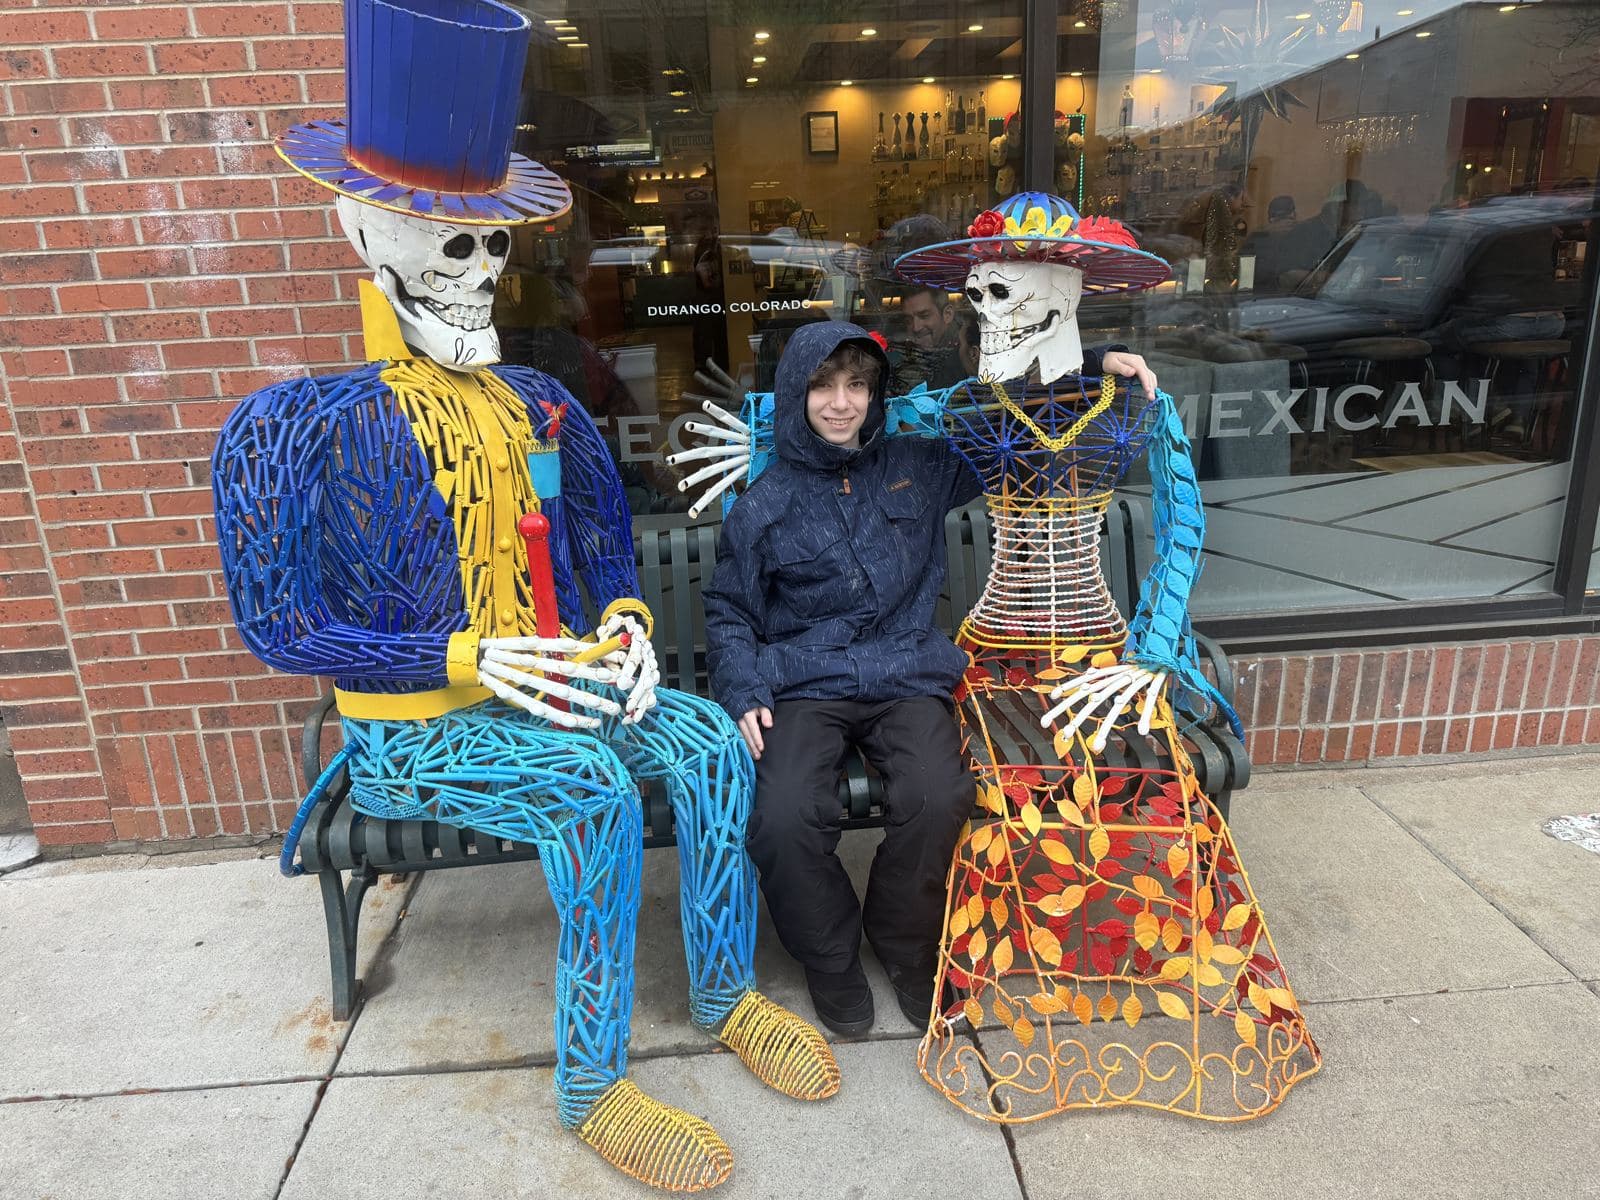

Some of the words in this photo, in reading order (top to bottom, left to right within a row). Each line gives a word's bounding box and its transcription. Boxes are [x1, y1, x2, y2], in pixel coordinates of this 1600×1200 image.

[648, 303, 726, 316] DURANGO,
[730, 299, 811, 313] COLORADO
[592, 412, 722, 464] EQ
